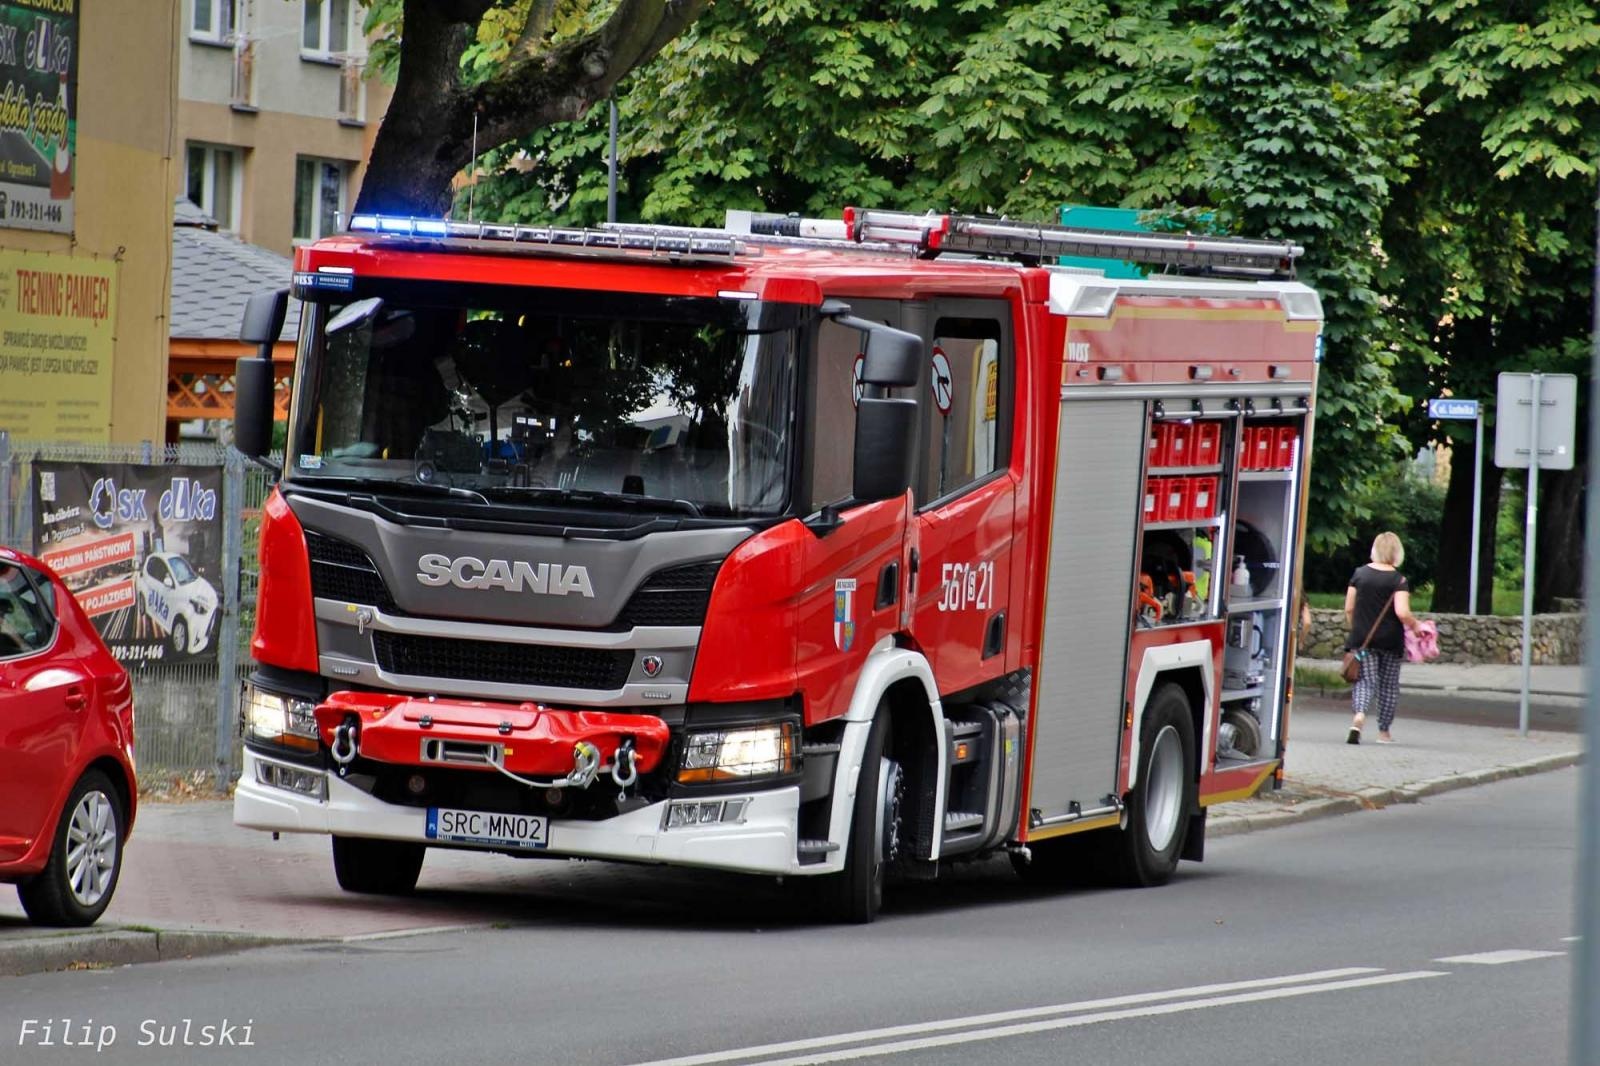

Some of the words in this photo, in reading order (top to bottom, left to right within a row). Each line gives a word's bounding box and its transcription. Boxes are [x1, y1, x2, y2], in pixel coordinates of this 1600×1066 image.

[16, 269, 63, 317] TRENING
[65, 272, 110, 328] PAMIĘCI
[416, 553, 595, 598] SCANIA
[442, 811, 481, 835] SRC
[488, 815, 541, 841] MN02
